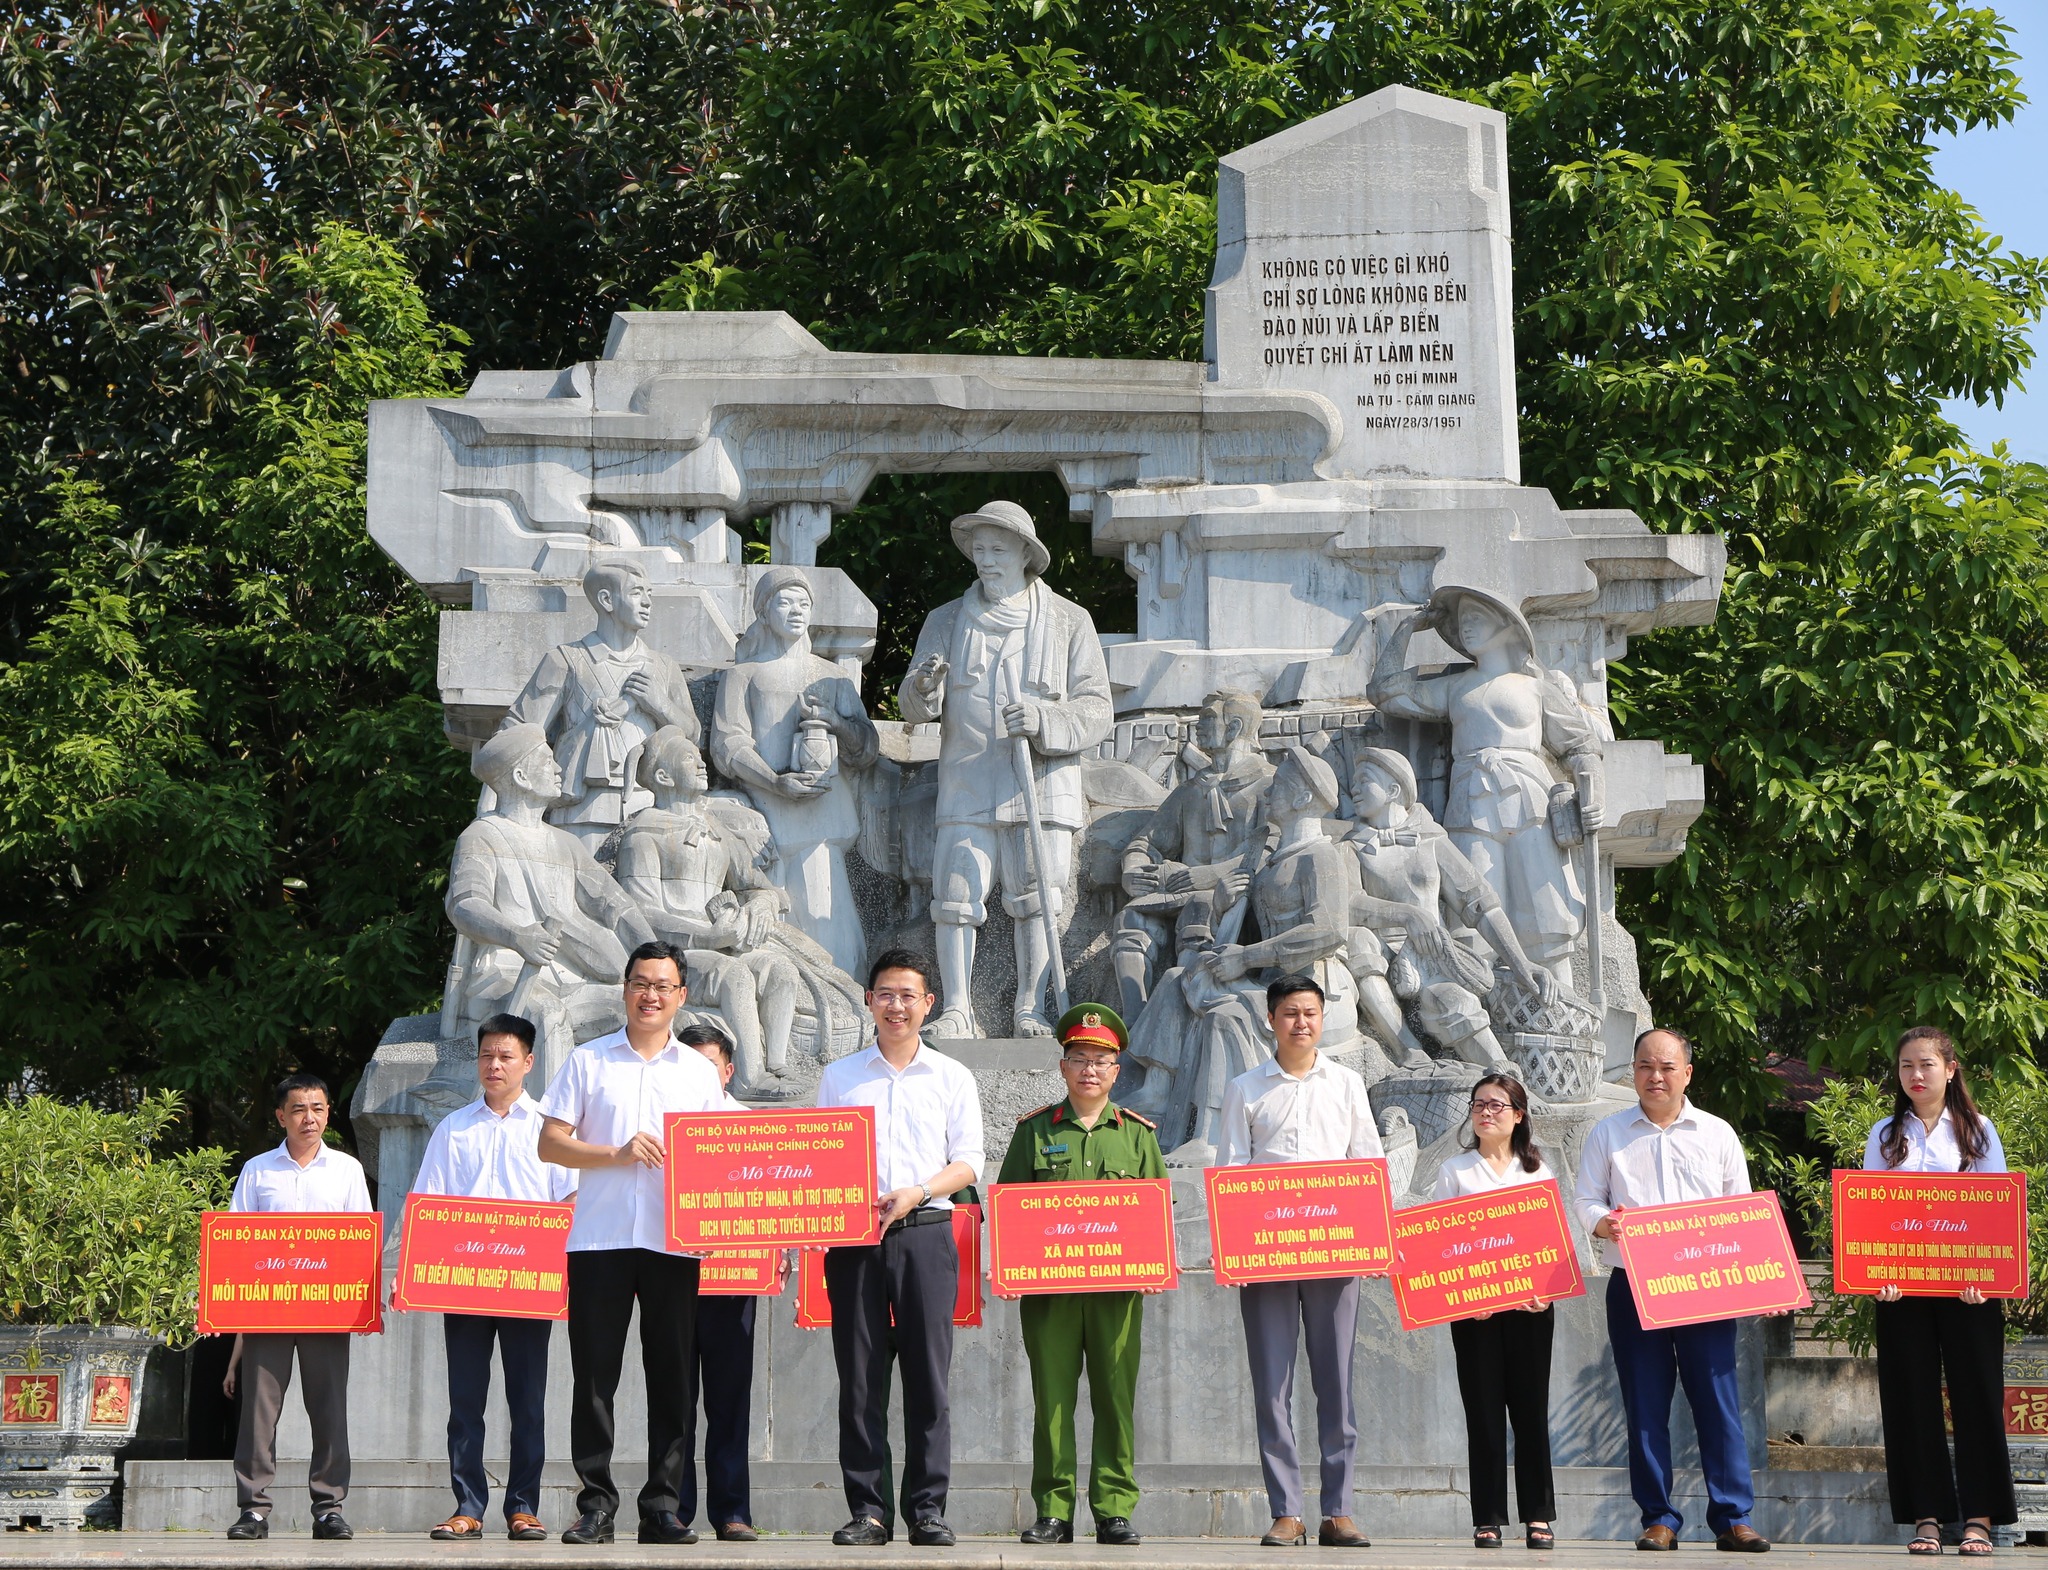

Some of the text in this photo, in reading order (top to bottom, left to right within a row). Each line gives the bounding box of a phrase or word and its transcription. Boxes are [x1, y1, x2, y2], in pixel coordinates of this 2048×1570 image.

[1262, 252, 1449, 278] KHÔNG CÓ VIỆC GÌ KHÓ
[1264, 278, 1467, 309] CHỈ SỢ LÒNG KHÔNG BỀN
[1263, 308, 1439, 336] ĐÀO NÚI VÀ LẤP BIỂN
[1264, 340, 1453, 367] QUYẾT CHÍ ẮT LÀM NÊN
[1396, 370, 1417, 384] CHÍ
[1423, 372, 1457, 384] MINH
[686, 1120, 853, 1138] CHI BỘ VĂN PHÒNG TRUNG TÂM
[696, 1137, 844, 1156] PHỤC VỤ HÀNH CHÍNH CÔNG
[728, 1164, 813, 1181] Mô Hình
[1218, 1171, 1378, 1195] ĐẢNG BỘ UỶ BAN NHÂN DÂN XÃ
[679, 1183, 864, 1210] NGÀY CUỐI TUẦN TIẾP NHẬN, HỖ TRỢ THỰC HIỆN
[1021, 1192, 1139, 1211] CHI BỘ CÔNG AN XÃ
[1848, 1185, 2011, 1204] CHI BỘ VĂN PHÒNG ĐẢNG UỶ
[419, 1208, 569, 1229] CHI BỘ UỶ BAN MẶT TRẬN TỔ QUỐC
[1264, 1204, 1338, 1220] Mô Hình
[1425, 1195, 1549, 1234] BỘ CÁC CƠ QUAN ĐẢNG
[1626, 1206, 1772, 1237] CHI BỘ BAN XÂY DỰNG ĐẢNG
[213, 1225, 371, 1243] CHI BỘ BAN XÂY DỰNG ĐẢNG
[700, 1210, 845, 1240] DỊCH VỤ CÔNG TRỰC TUYẾN TẠI CƠ SỞ
[1045, 1222, 1118, 1236] Mô Hình
[1254, 1224, 1354, 1246] XÂY DỰNG MÔ HÌNH
[1891, 1218, 1969, 1232] Mô Hình
[1044, 1241, 1122, 1258] XÃ AN TOÀN
[1442, 1233, 1515, 1259] Mô Hình
[1674, 1241, 1742, 1261] Mô Hình
[255, 1258, 328, 1270] Mô Hình
[1225, 1246, 1388, 1270] DU LỊCH CỘNG ĐỒNG PHIÊNG AN
[1409, 1245, 1559, 1291] MỖI QUÝ MỘT VIỆC TỐT
[413, 1258, 562, 1292] THÍ ĐIỂM NÔNG NGHIỆP THÔNG MINH
[1004, 1263, 1165, 1280] TRÊN KHÔNG GIAN MẠNG
[1647, 1257, 1786, 1296] ĐƯỜNG CỜ TỔ QUỐC
[212, 1278, 369, 1304] MỖI TUẦN MỘT NGHỊ QUYẾT
[1445, 1276, 1534, 1306] VÌ NHÂN DÂN
